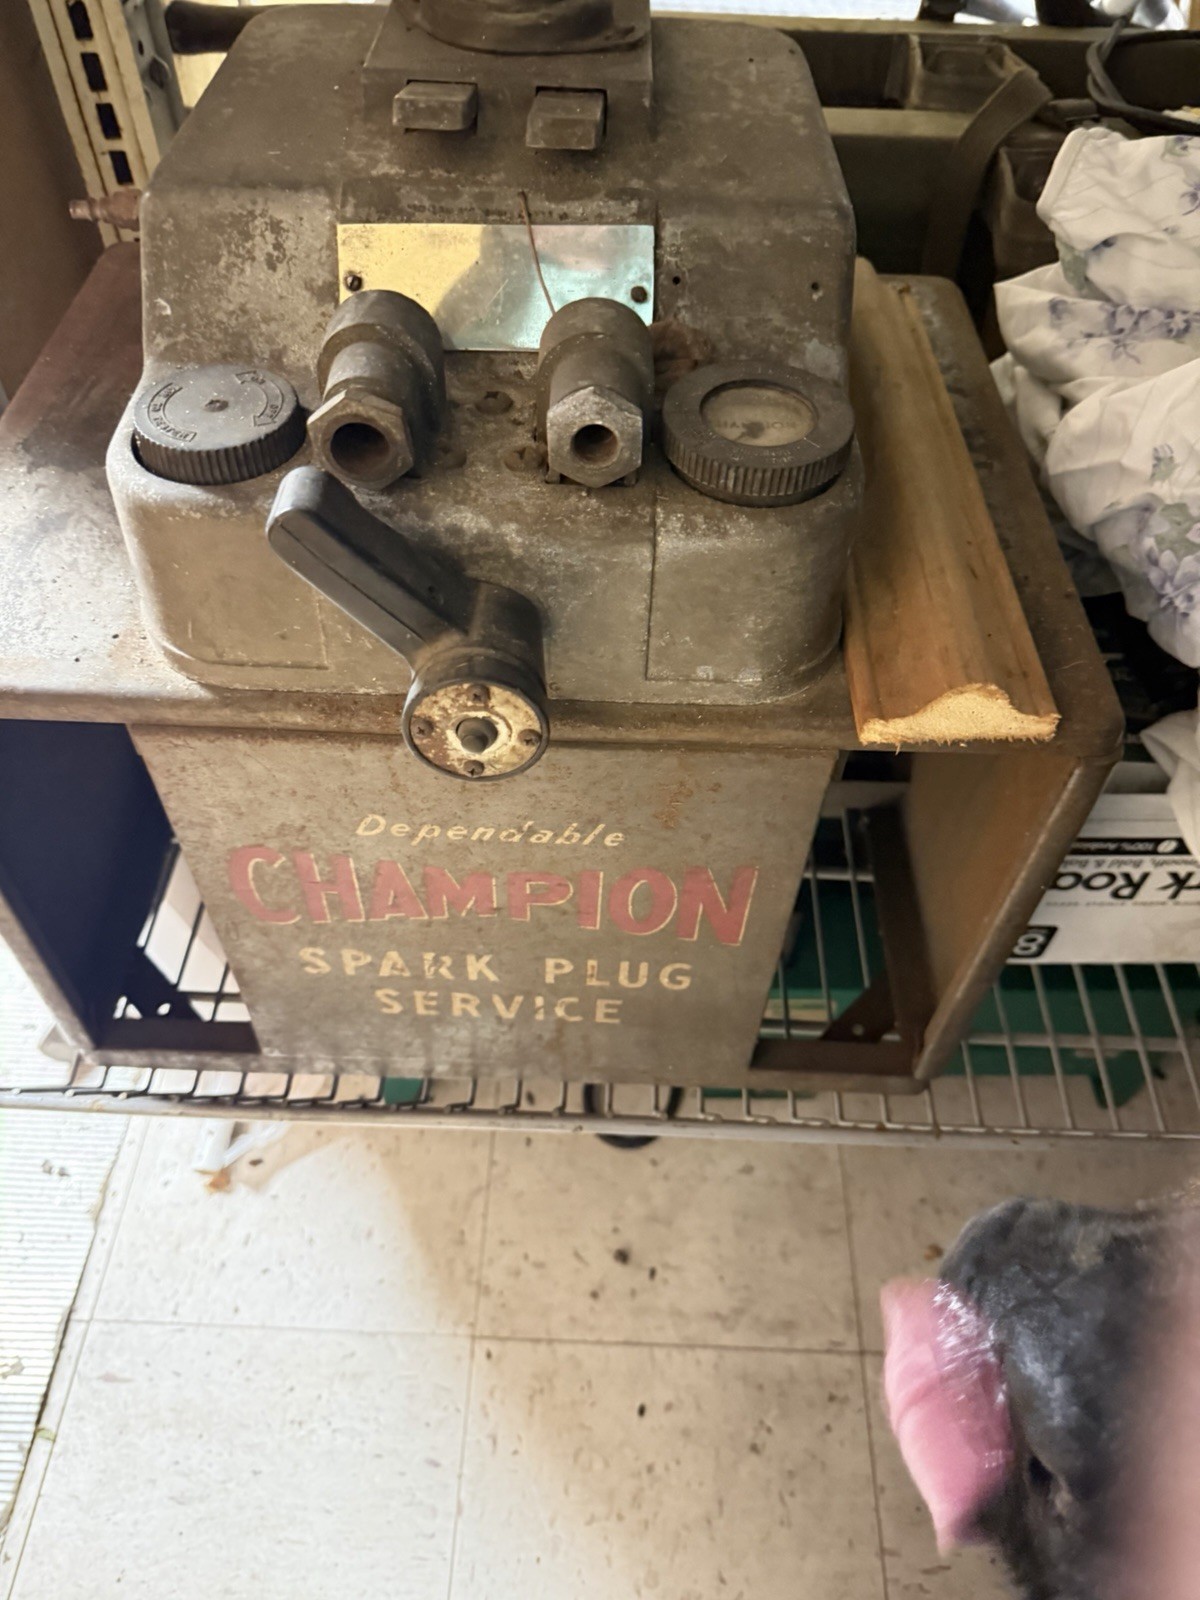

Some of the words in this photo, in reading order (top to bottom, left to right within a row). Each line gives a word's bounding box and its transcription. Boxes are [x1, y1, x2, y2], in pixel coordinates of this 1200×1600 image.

[355, 813, 626, 847] Dependable
[228, 844, 759, 946] CHAMPION
[299, 946, 500, 983] SPARK
[544, 957, 693, 990] PLUG
[374, 987, 624, 1024] SERVICE
